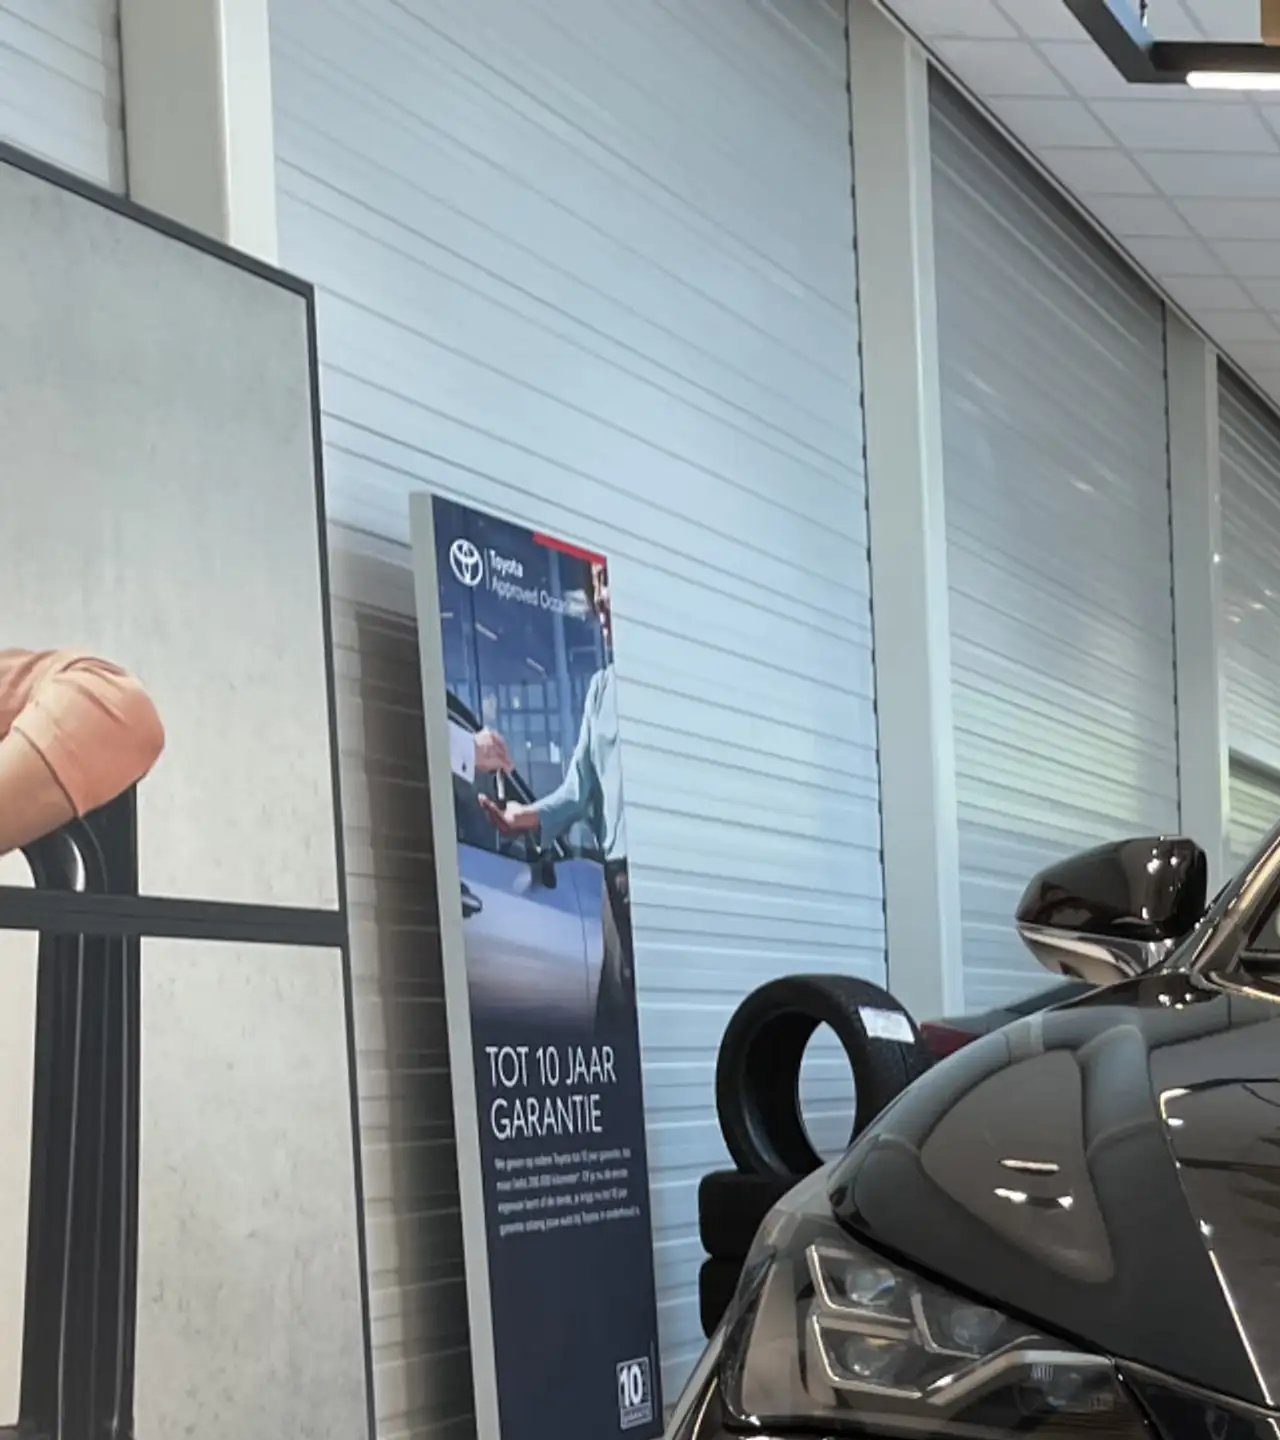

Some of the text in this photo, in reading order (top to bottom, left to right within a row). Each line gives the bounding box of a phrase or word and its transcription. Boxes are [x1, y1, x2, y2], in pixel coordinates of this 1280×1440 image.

[489, 549, 524, 579] Toyota
[485, 1046, 617, 1088] TOT 10 JAAR
[490, 1094, 603, 1141] GARANTIE
[620, 1363, 644, 1409] 10
